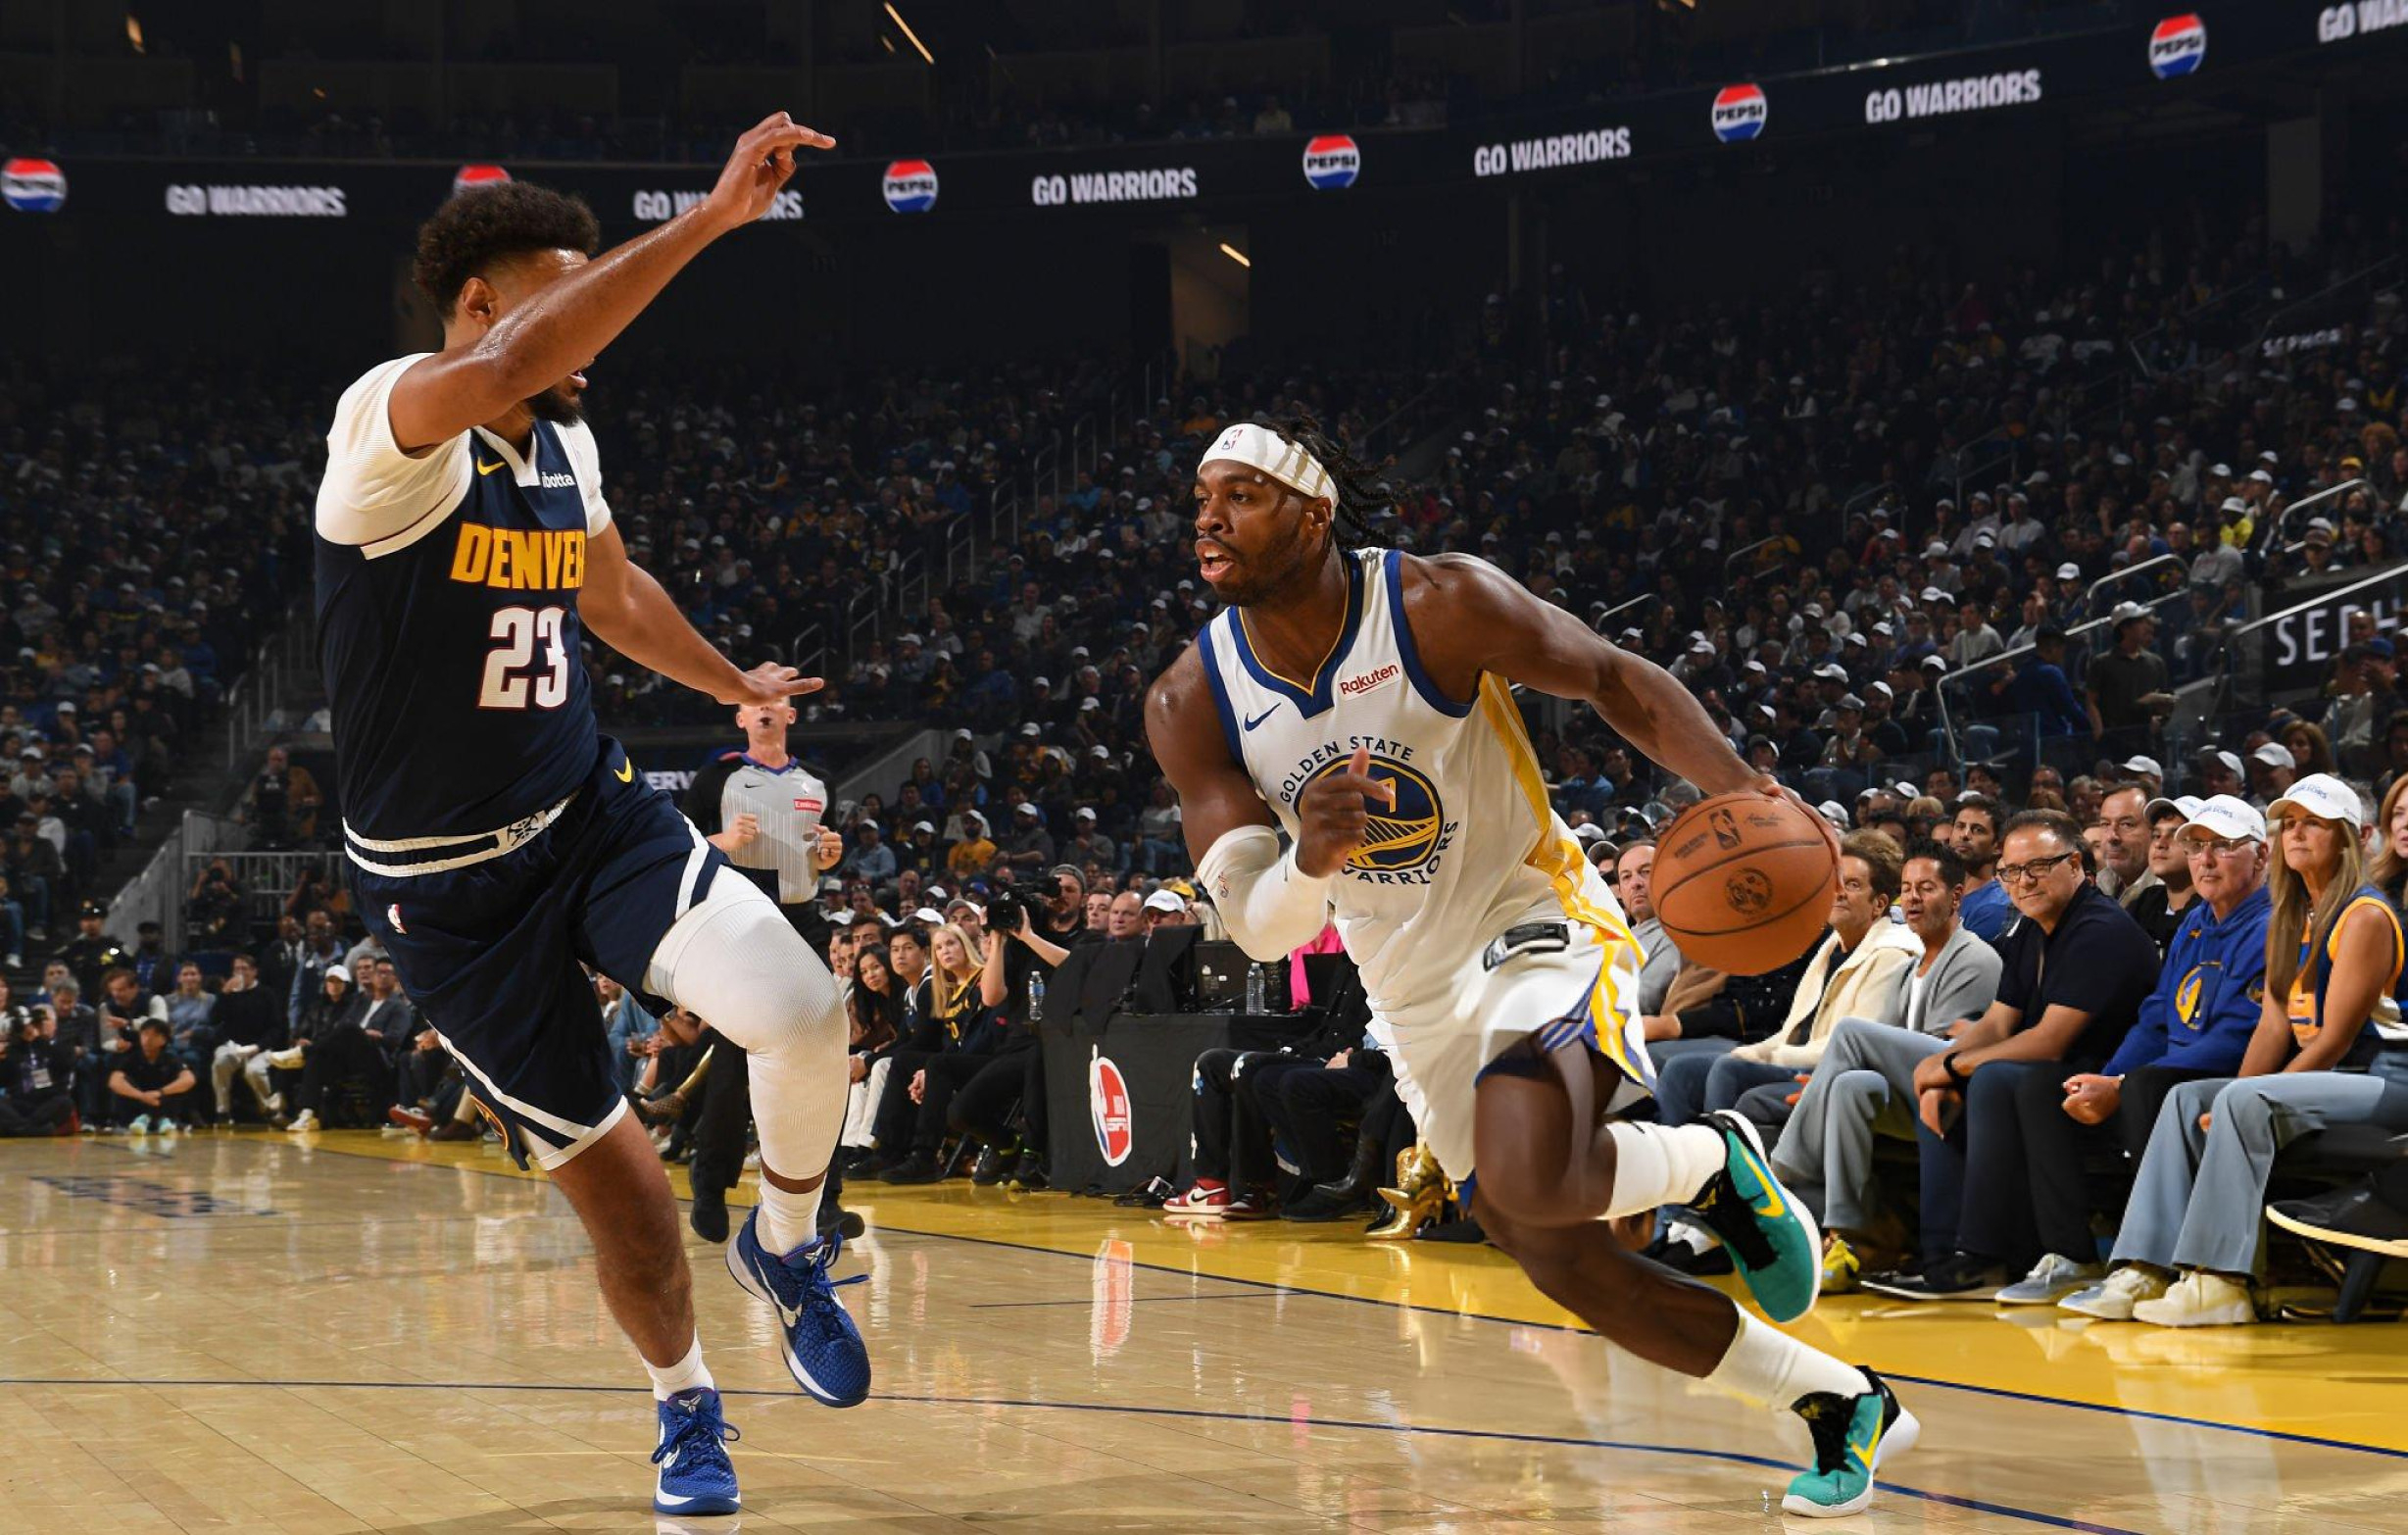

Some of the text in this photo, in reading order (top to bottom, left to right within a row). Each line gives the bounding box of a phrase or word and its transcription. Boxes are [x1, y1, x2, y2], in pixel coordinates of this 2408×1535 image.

[2318, 2, 2355, 43] GO
[1716, 104, 1762, 122] PEPSI
[1865, 69, 2041, 124] GO WARRIORS
[1306, 154, 1356, 170] PEPSI
[1474, 126, 1631, 176] GO WARRIORS
[1033, 168, 1197, 205] GO WARRIORS
[633, 191, 670, 220] GO
[542, 471, 575, 488] ibotta
[477, 604, 569, 711] 23
[1340, 664, 1399, 695] Rakuten
[1280, 736, 1413, 803] GOLDEN STATE
